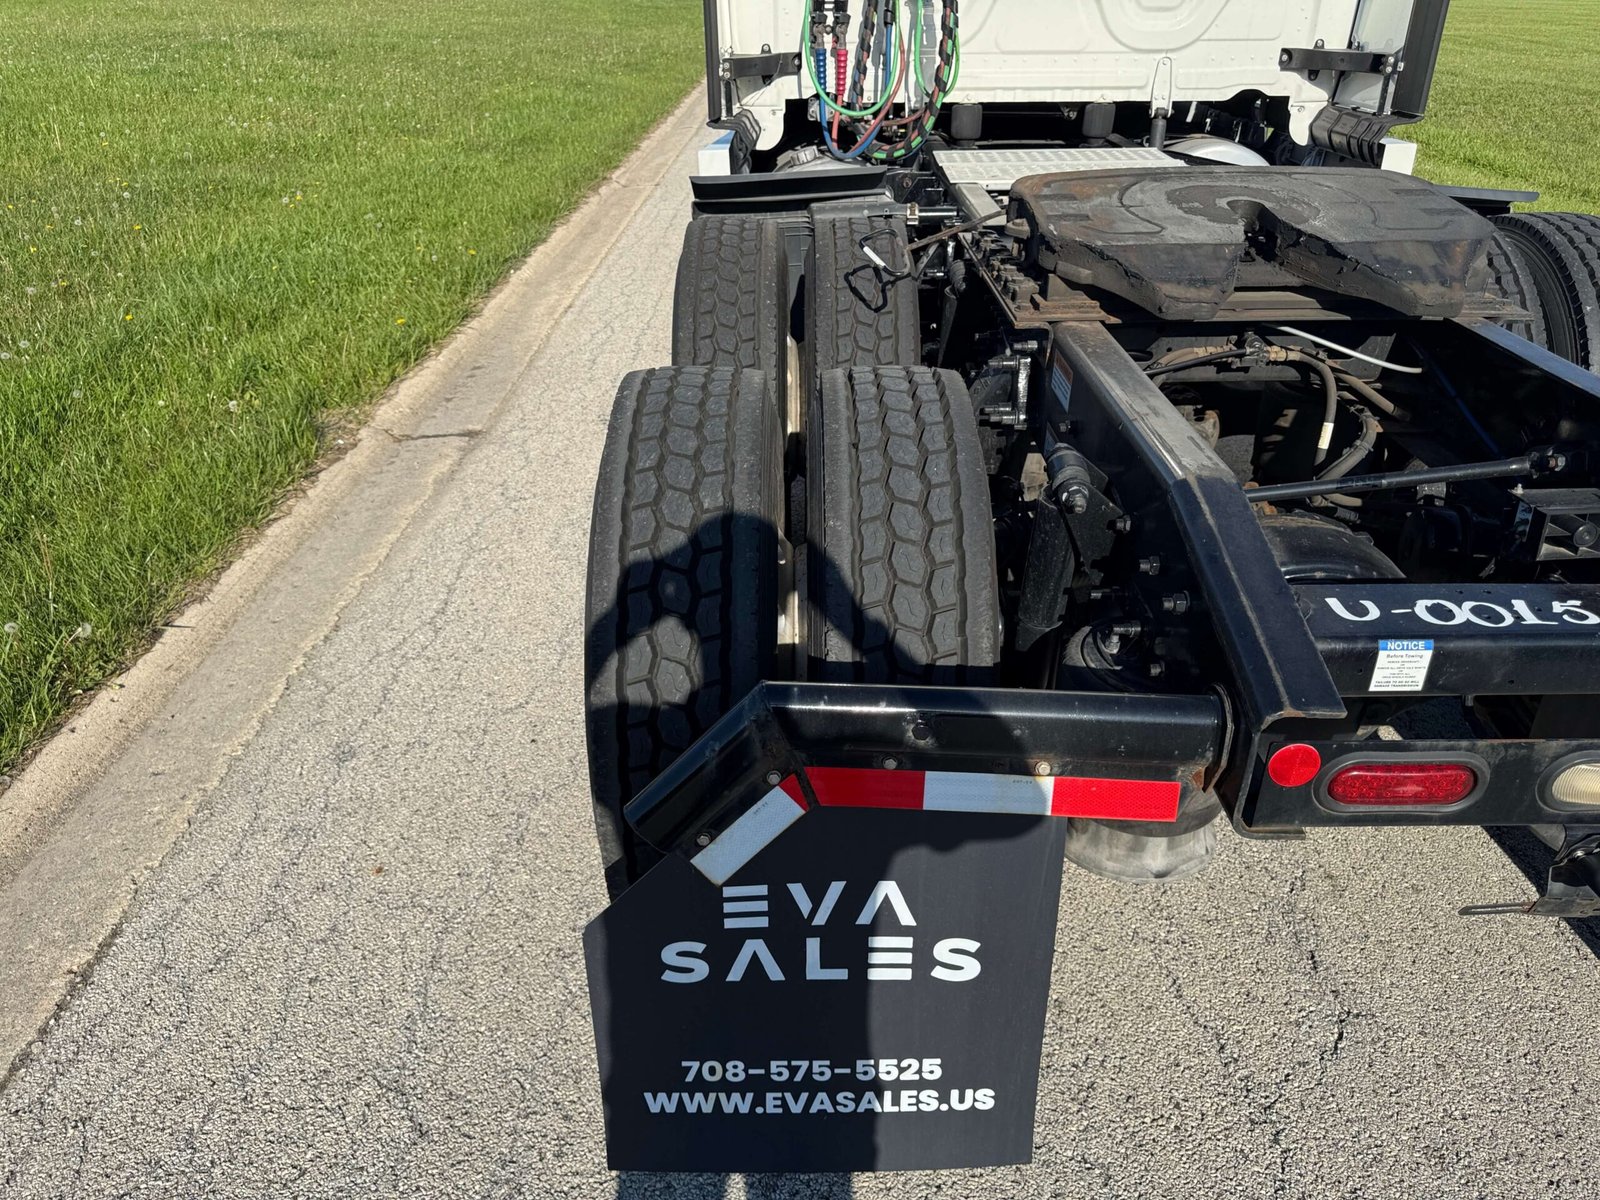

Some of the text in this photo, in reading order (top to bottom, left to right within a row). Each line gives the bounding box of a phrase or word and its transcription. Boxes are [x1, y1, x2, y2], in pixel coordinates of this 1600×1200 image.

[1325, 598, 1600, 627] U-0015
[1387, 641, 1425, 650] NOTICE
[722, 880, 918, 929] EVA
[661, 936, 982, 983] SALES
[681, 1058, 943, 1082] 708-575-5525
[643, 1088, 996, 1114] WWW.EVASALES.US
